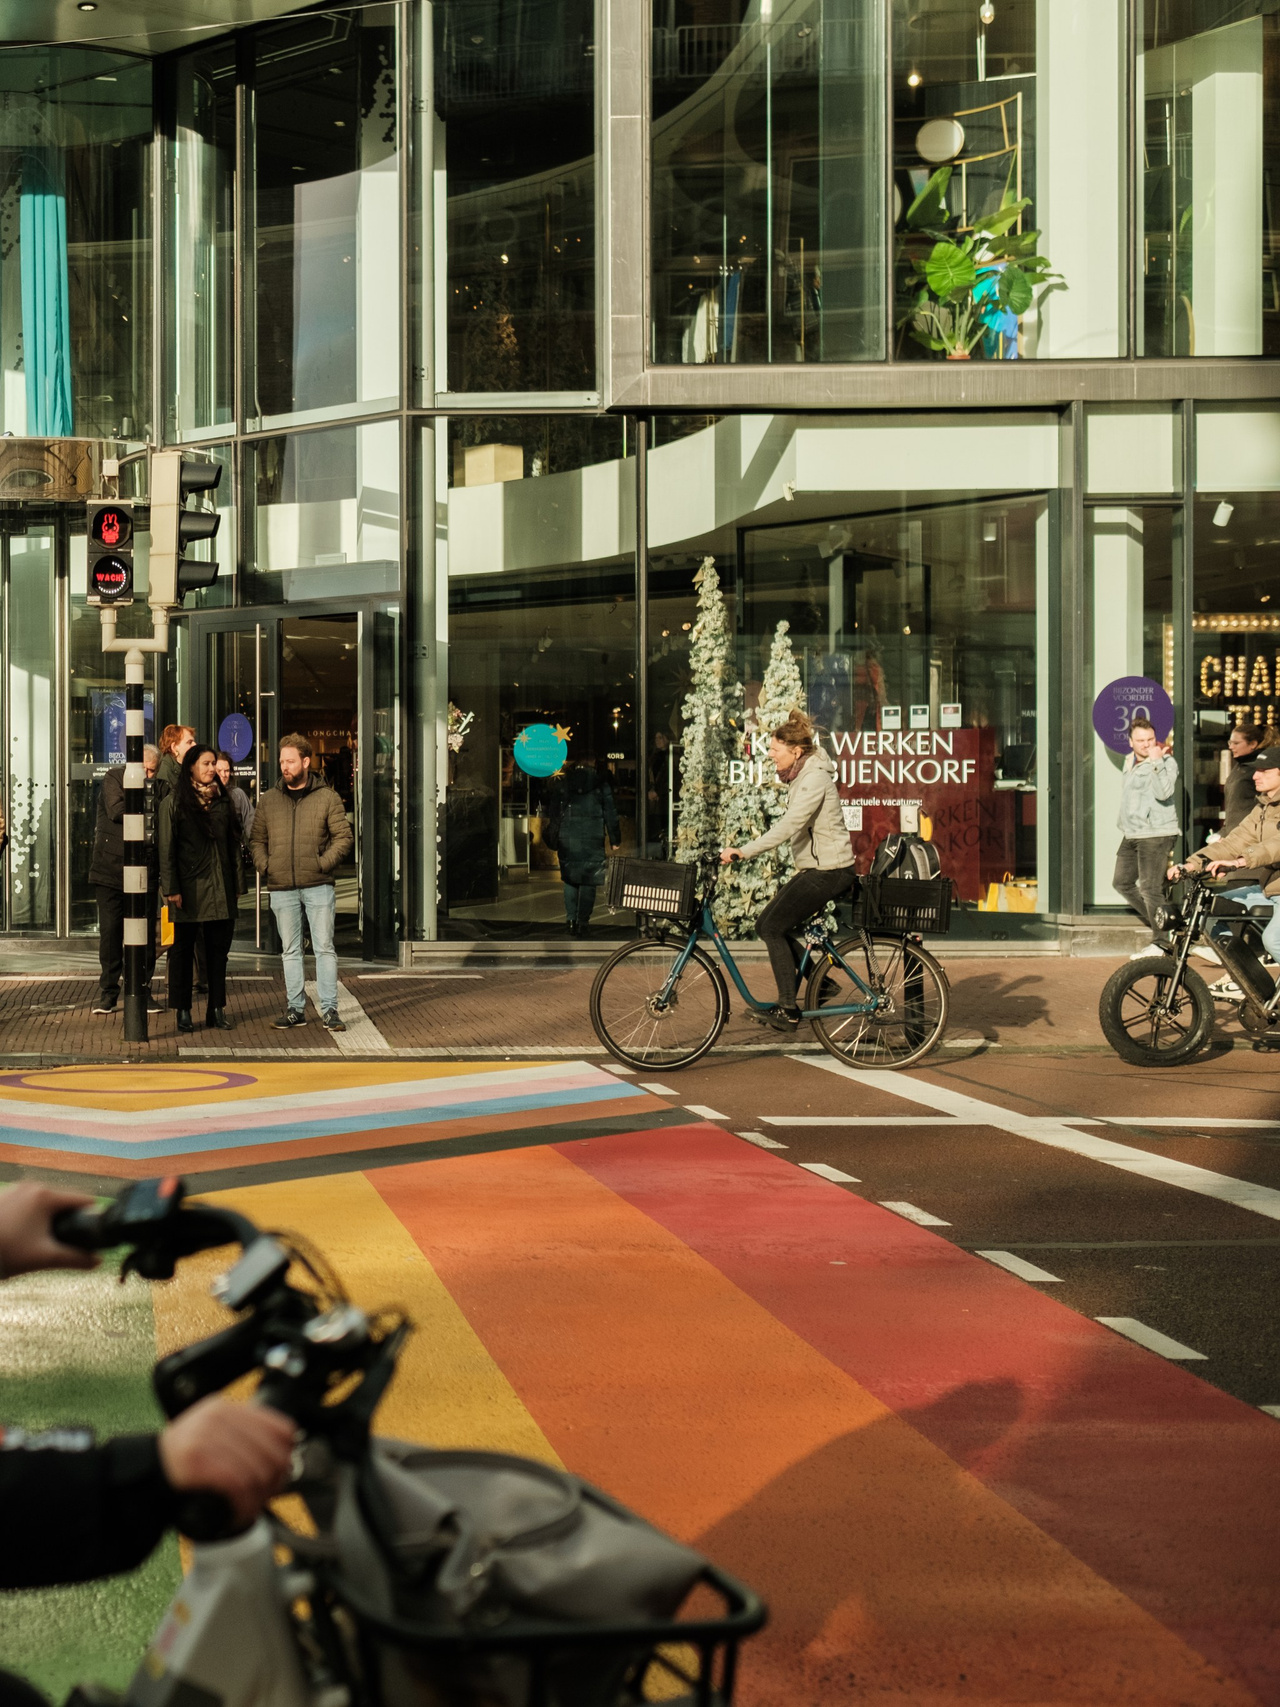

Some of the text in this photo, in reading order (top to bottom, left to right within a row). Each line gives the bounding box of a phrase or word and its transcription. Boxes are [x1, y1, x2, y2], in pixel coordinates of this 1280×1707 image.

[1201, 655, 1280, 697] CHA
[1021, 709, 1036, 717] HAN
[830, 731, 954, 756] WERKEN
[729, 759, 763, 788] BIJ
[851, 796, 880, 806] actuele
